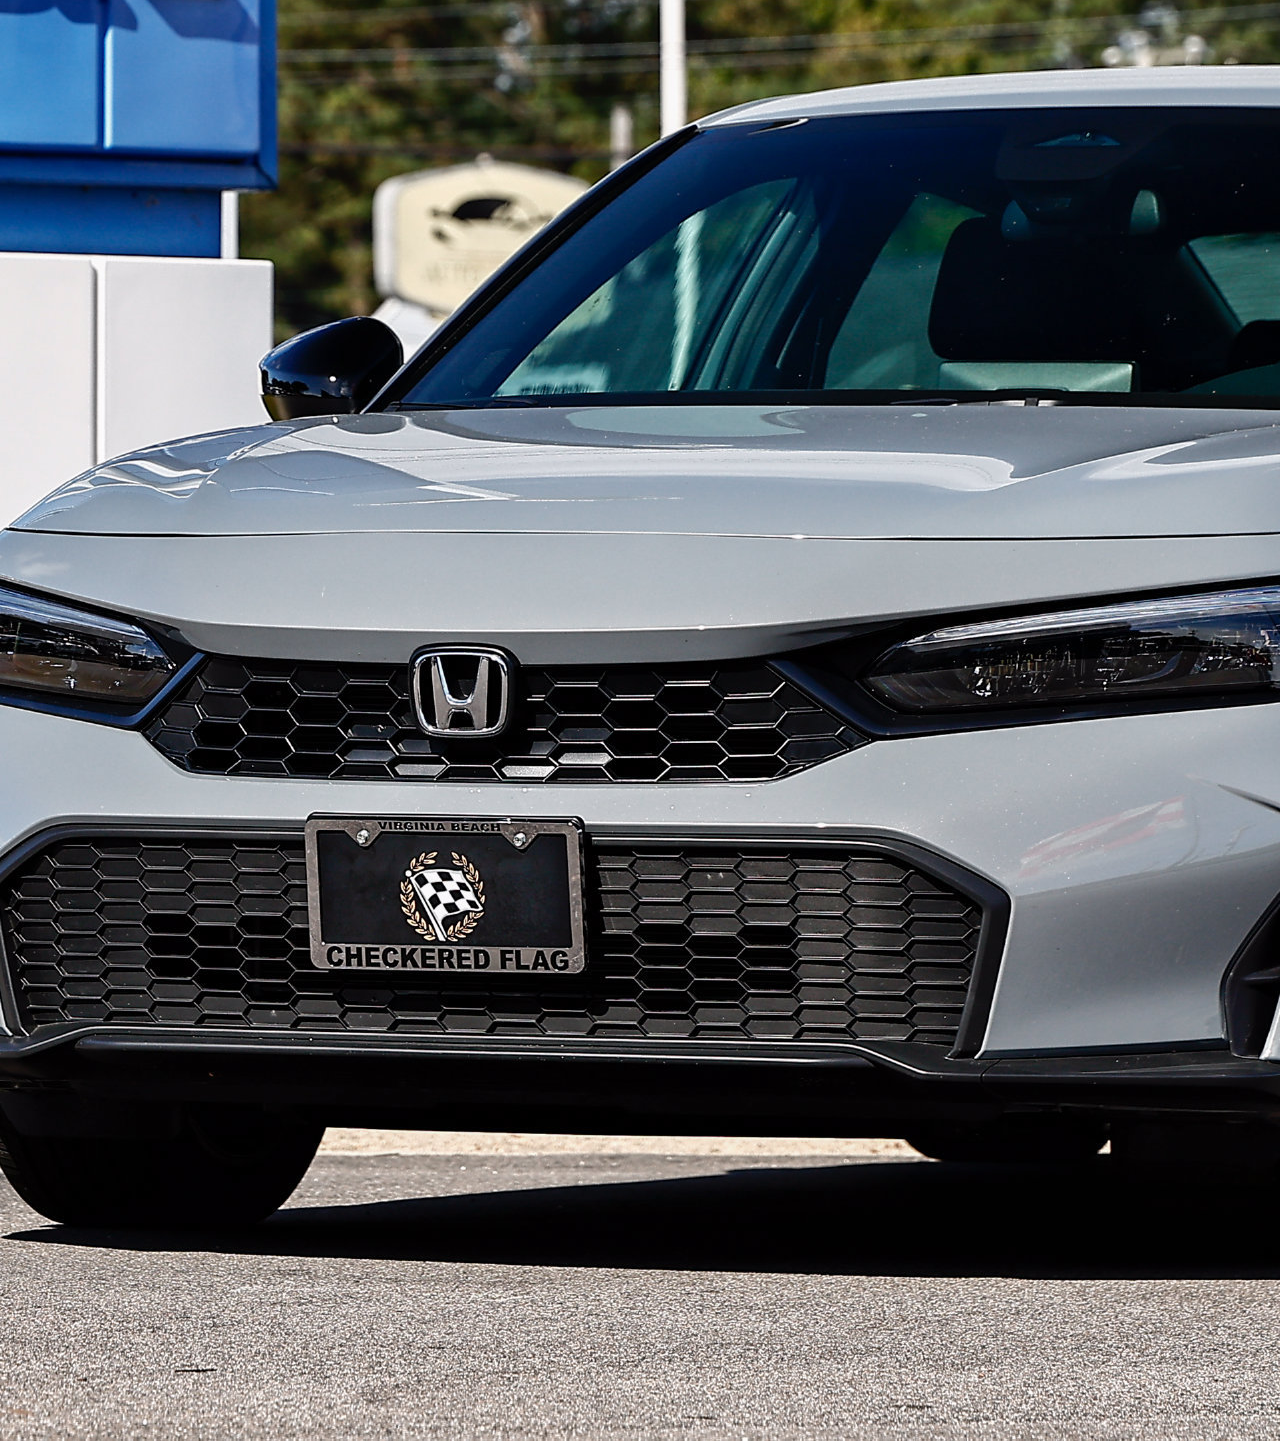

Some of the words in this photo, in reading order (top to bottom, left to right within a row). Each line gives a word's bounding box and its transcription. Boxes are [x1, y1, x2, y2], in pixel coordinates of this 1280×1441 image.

[377, 821, 444, 831] VIRGINIA
[452, 822, 501, 832] BEACH
[326, 946, 490, 970] CHECKERED
[499, 949, 569, 971] FLAG
